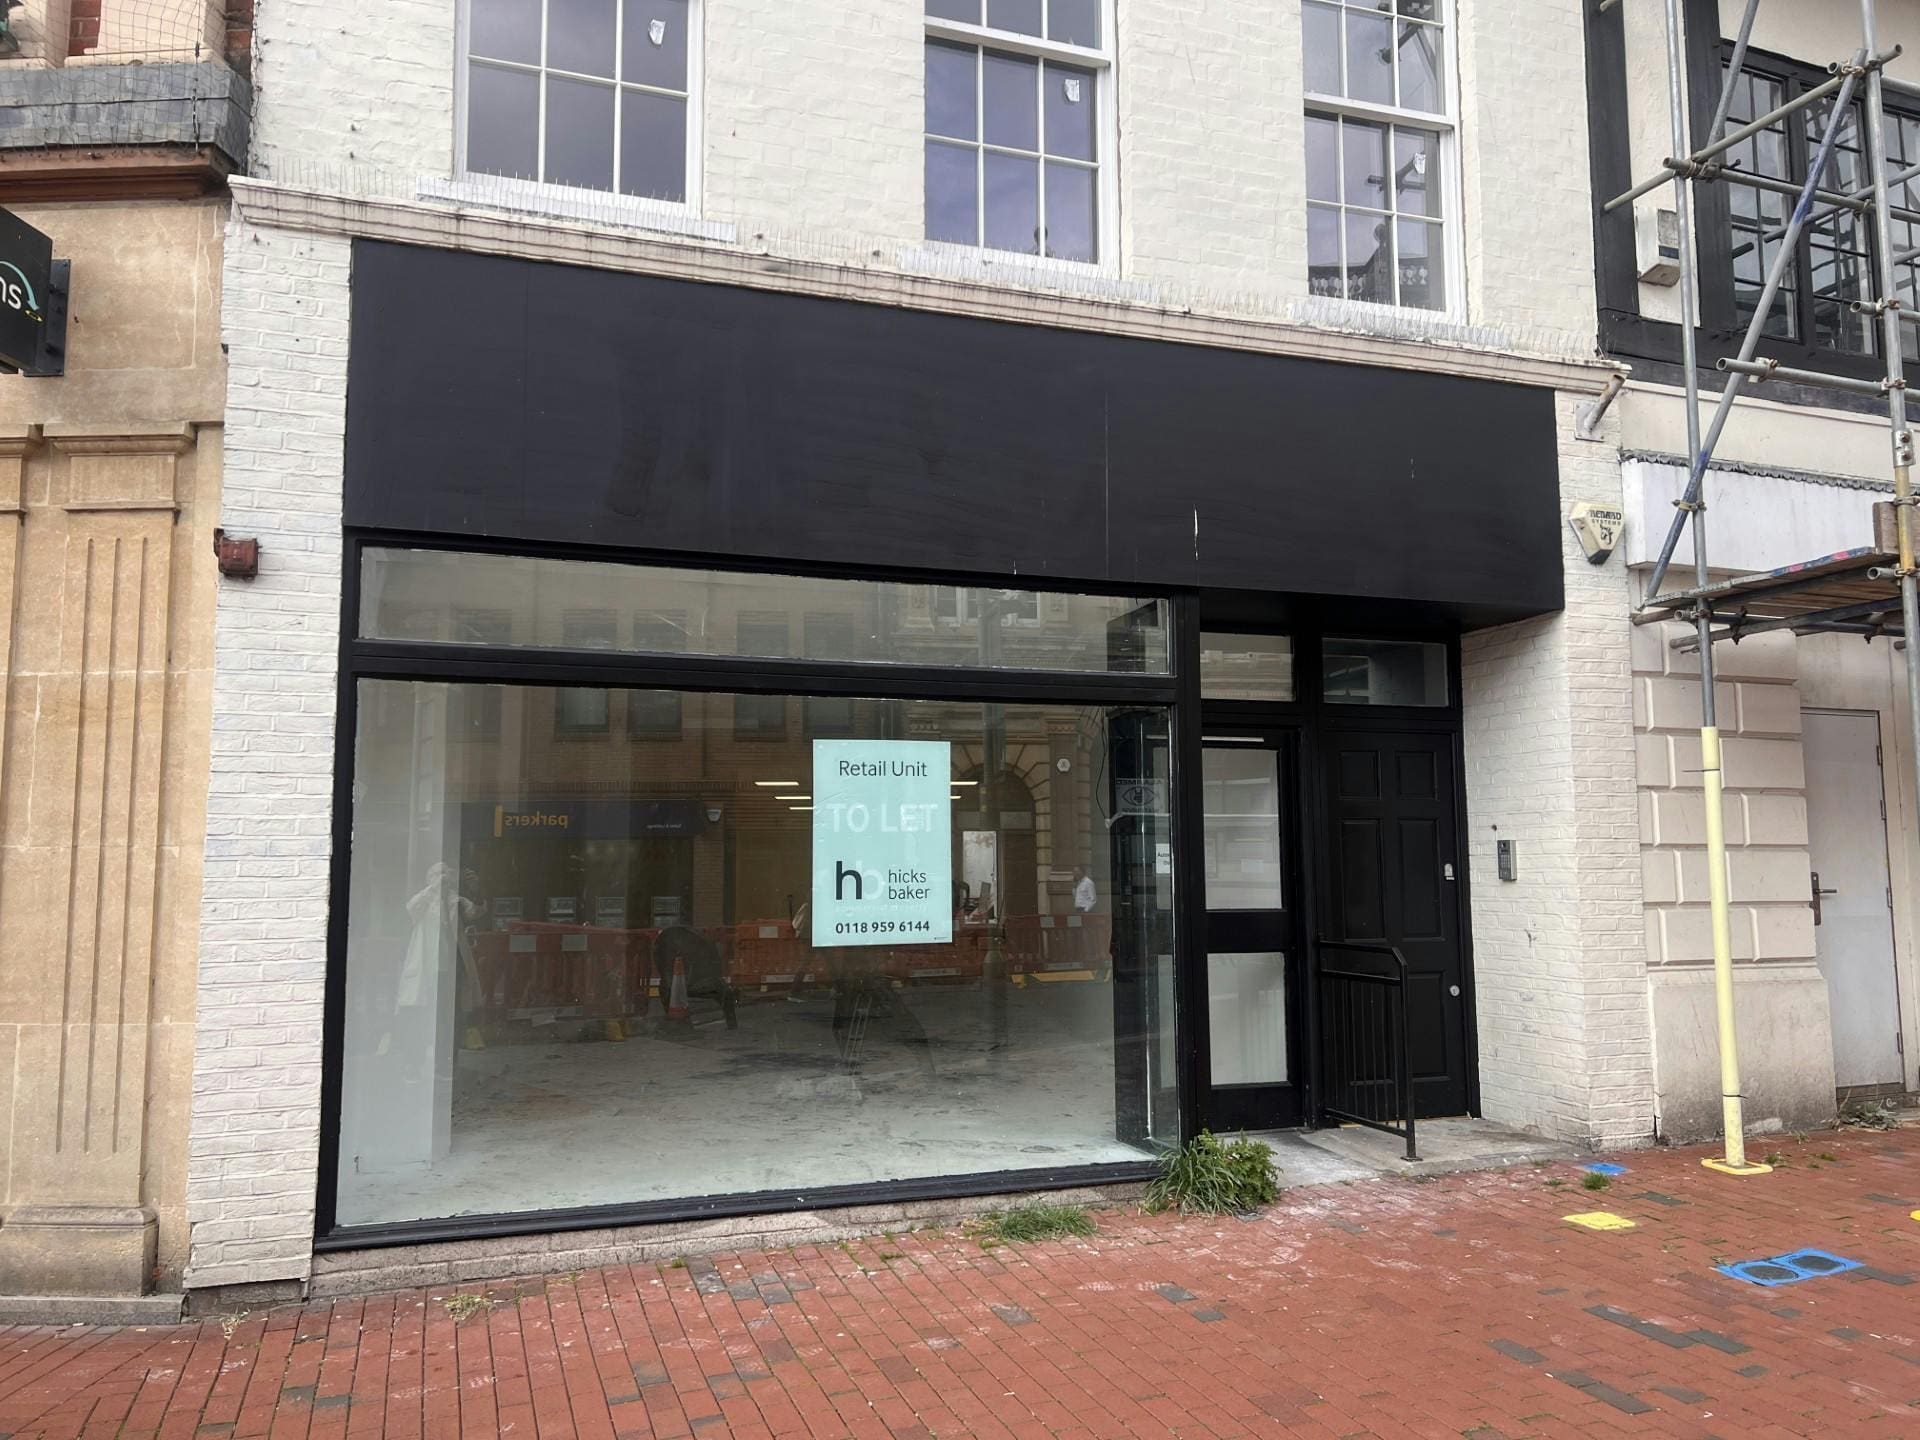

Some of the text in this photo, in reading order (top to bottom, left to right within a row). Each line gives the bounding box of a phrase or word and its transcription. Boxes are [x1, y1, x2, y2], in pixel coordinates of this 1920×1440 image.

[839, 760, 928, 777] Retail Unit
[826, 803, 938, 833] TO LET
[888, 869, 927, 883] hicks
[888, 886, 931, 900] baker
[835, 920, 930, 934] 0118 959 6144
